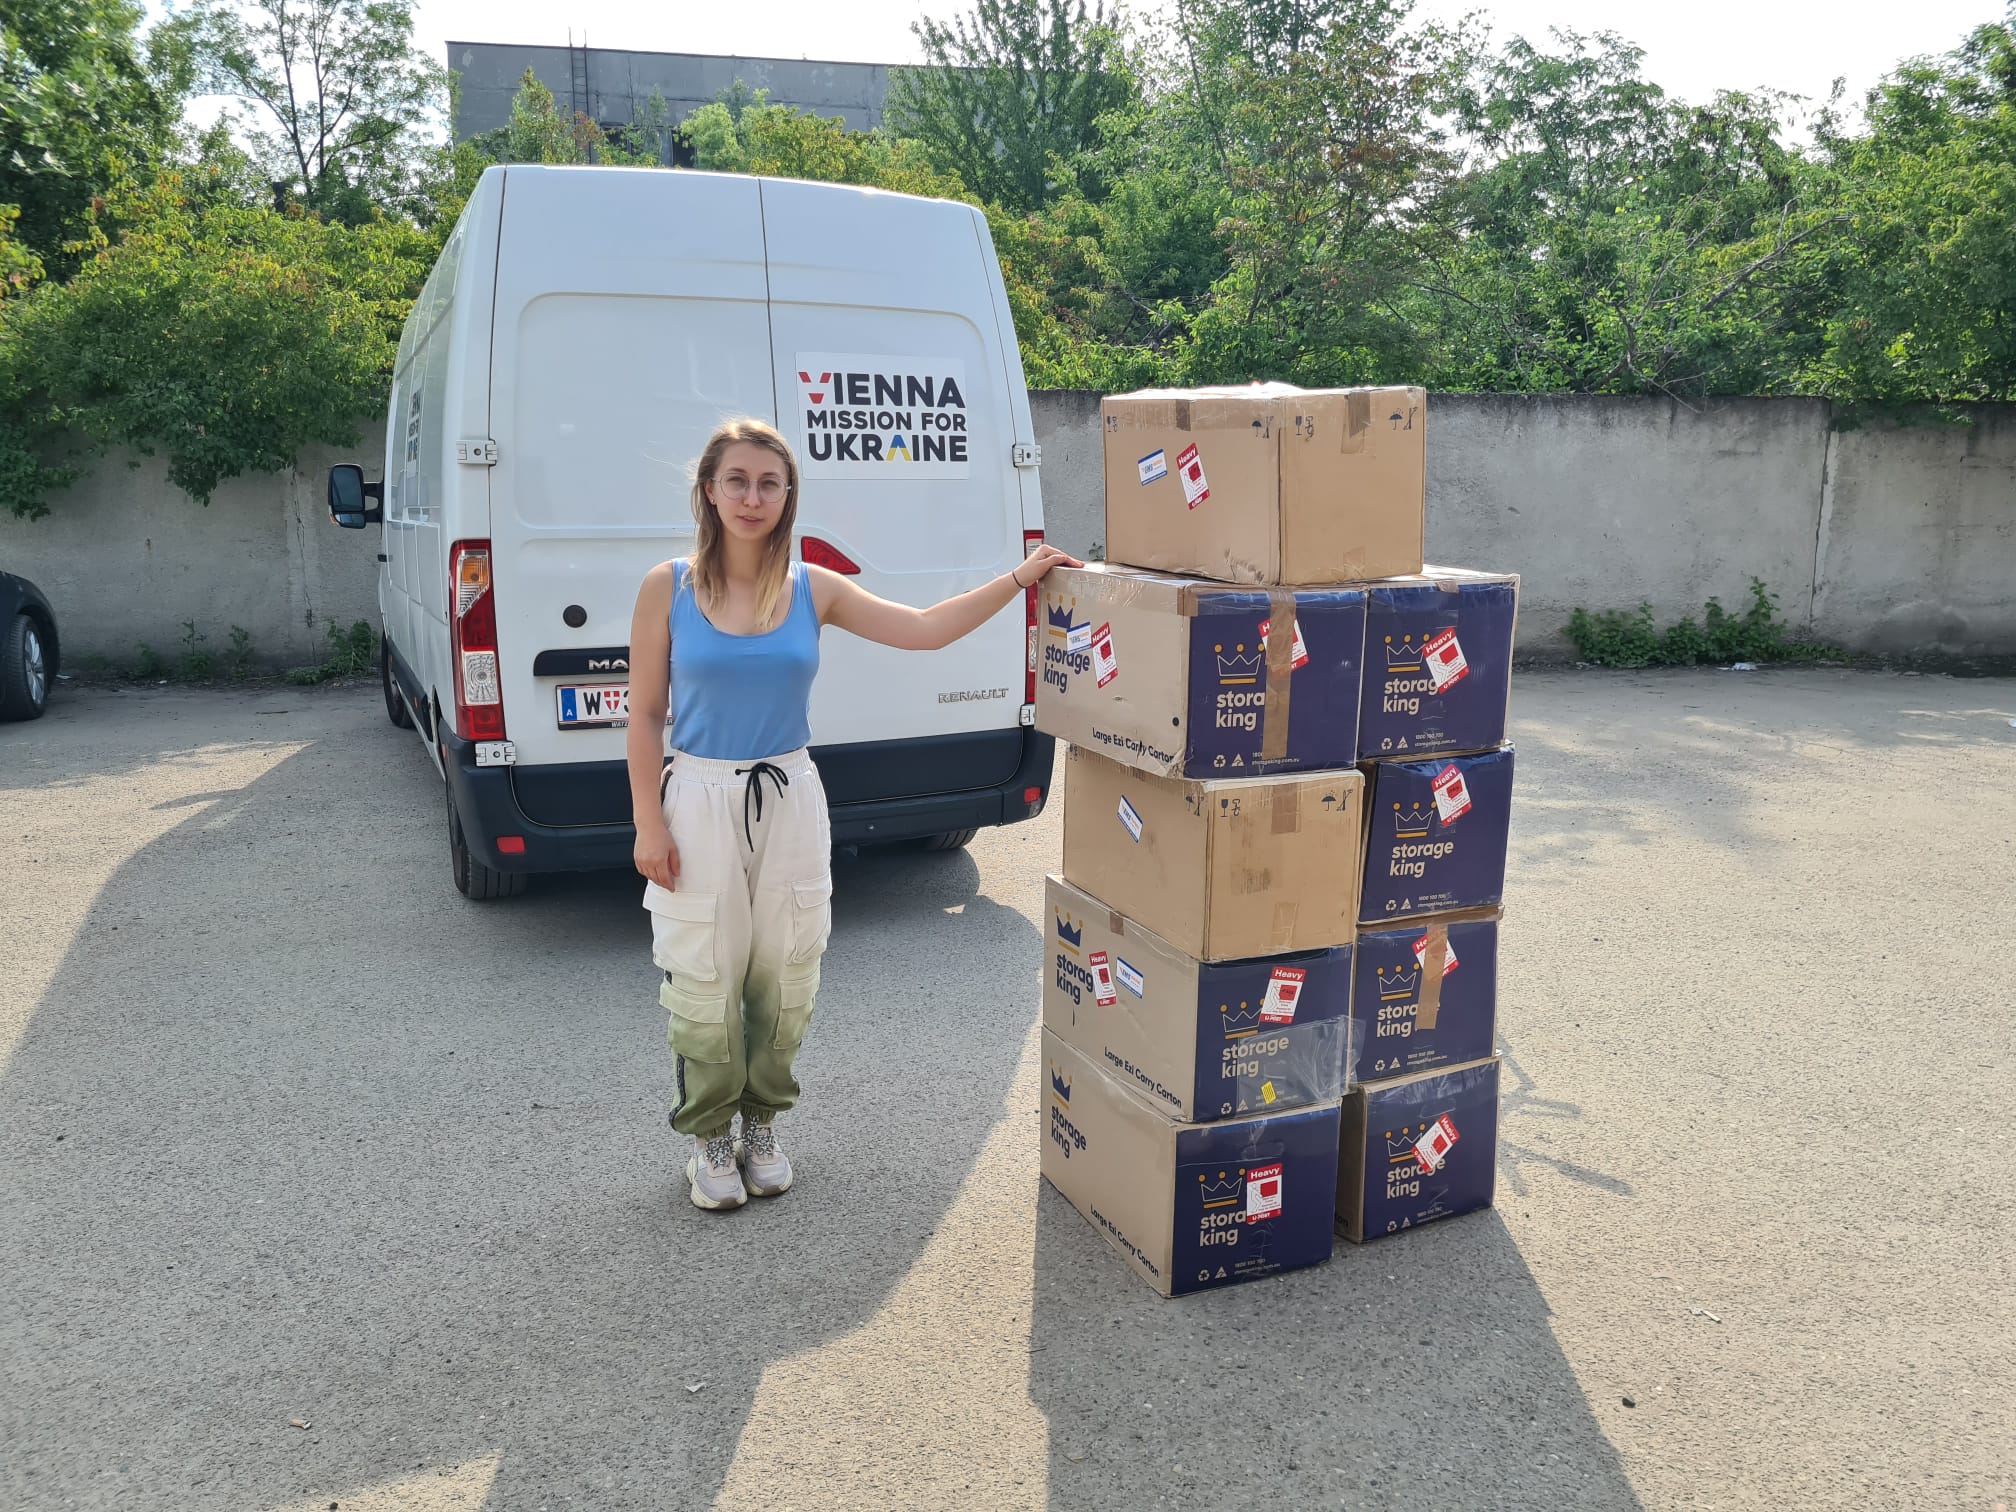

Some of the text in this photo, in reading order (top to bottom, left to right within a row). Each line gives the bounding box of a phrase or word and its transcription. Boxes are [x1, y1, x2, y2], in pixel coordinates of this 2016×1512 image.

[798, 371, 966, 408] VIENNA
[806, 410, 967, 432] MISSION FOR
[808, 433, 968, 462] UKRAINE
[1178, 447, 1197, 466] Heavy
[1091, 627, 1109, 644] Heavy
[1424, 630, 1453, 654] Heavy
[588, 658, 630, 671] MA
[1045, 643, 1091, 675] storage
[1043, 662, 1068, 694] king
[1384, 678, 1440, 696] storag
[583, 691, 601, 716] W
[938, 687, 1009, 704] RENAULT
[1216, 690, 1266, 708] stora
[1382, 695, 1420, 716] king
[566, 708, 574, 717] A
[1215, 709, 1257, 732] king
[1092, 727, 1112, 745] Large
[1113, 733, 1124, 747] Ezi
[1435, 767, 1457, 788] Heavy
[1391, 841, 1454, 860] storage
[1389, 859, 1426, 879] king
[1056, 953, 1095, 993] storag
[1274, 969, 1303, 981] Heavy
[1056, 970, 1081, 1006] king
[1377, 1003, 1419, 1021] stora
[1376, 1020, 1412, 1038] king
[1222, 1037, 1290, 1061] storage
[1104, 1046, 1182, 1109] Large Ezi Carry Carton
[1221, 1060, 1259, 1079] king
[1051, 1105, 1087, 1151] storage
[1440, 1117, 1457, 1142] Heavy
[1051, 1119, 1070, 1159] king
[1250, 1167, 1280, 1180] Heavy
[1386, 1181, 1420, 1199] king
[1200, 1209, 1254, 1230] stora
[1090, 1202, 1159, 1279] Large Ezi Carry Carton
[1199, 1228, 1239, 1247] king
